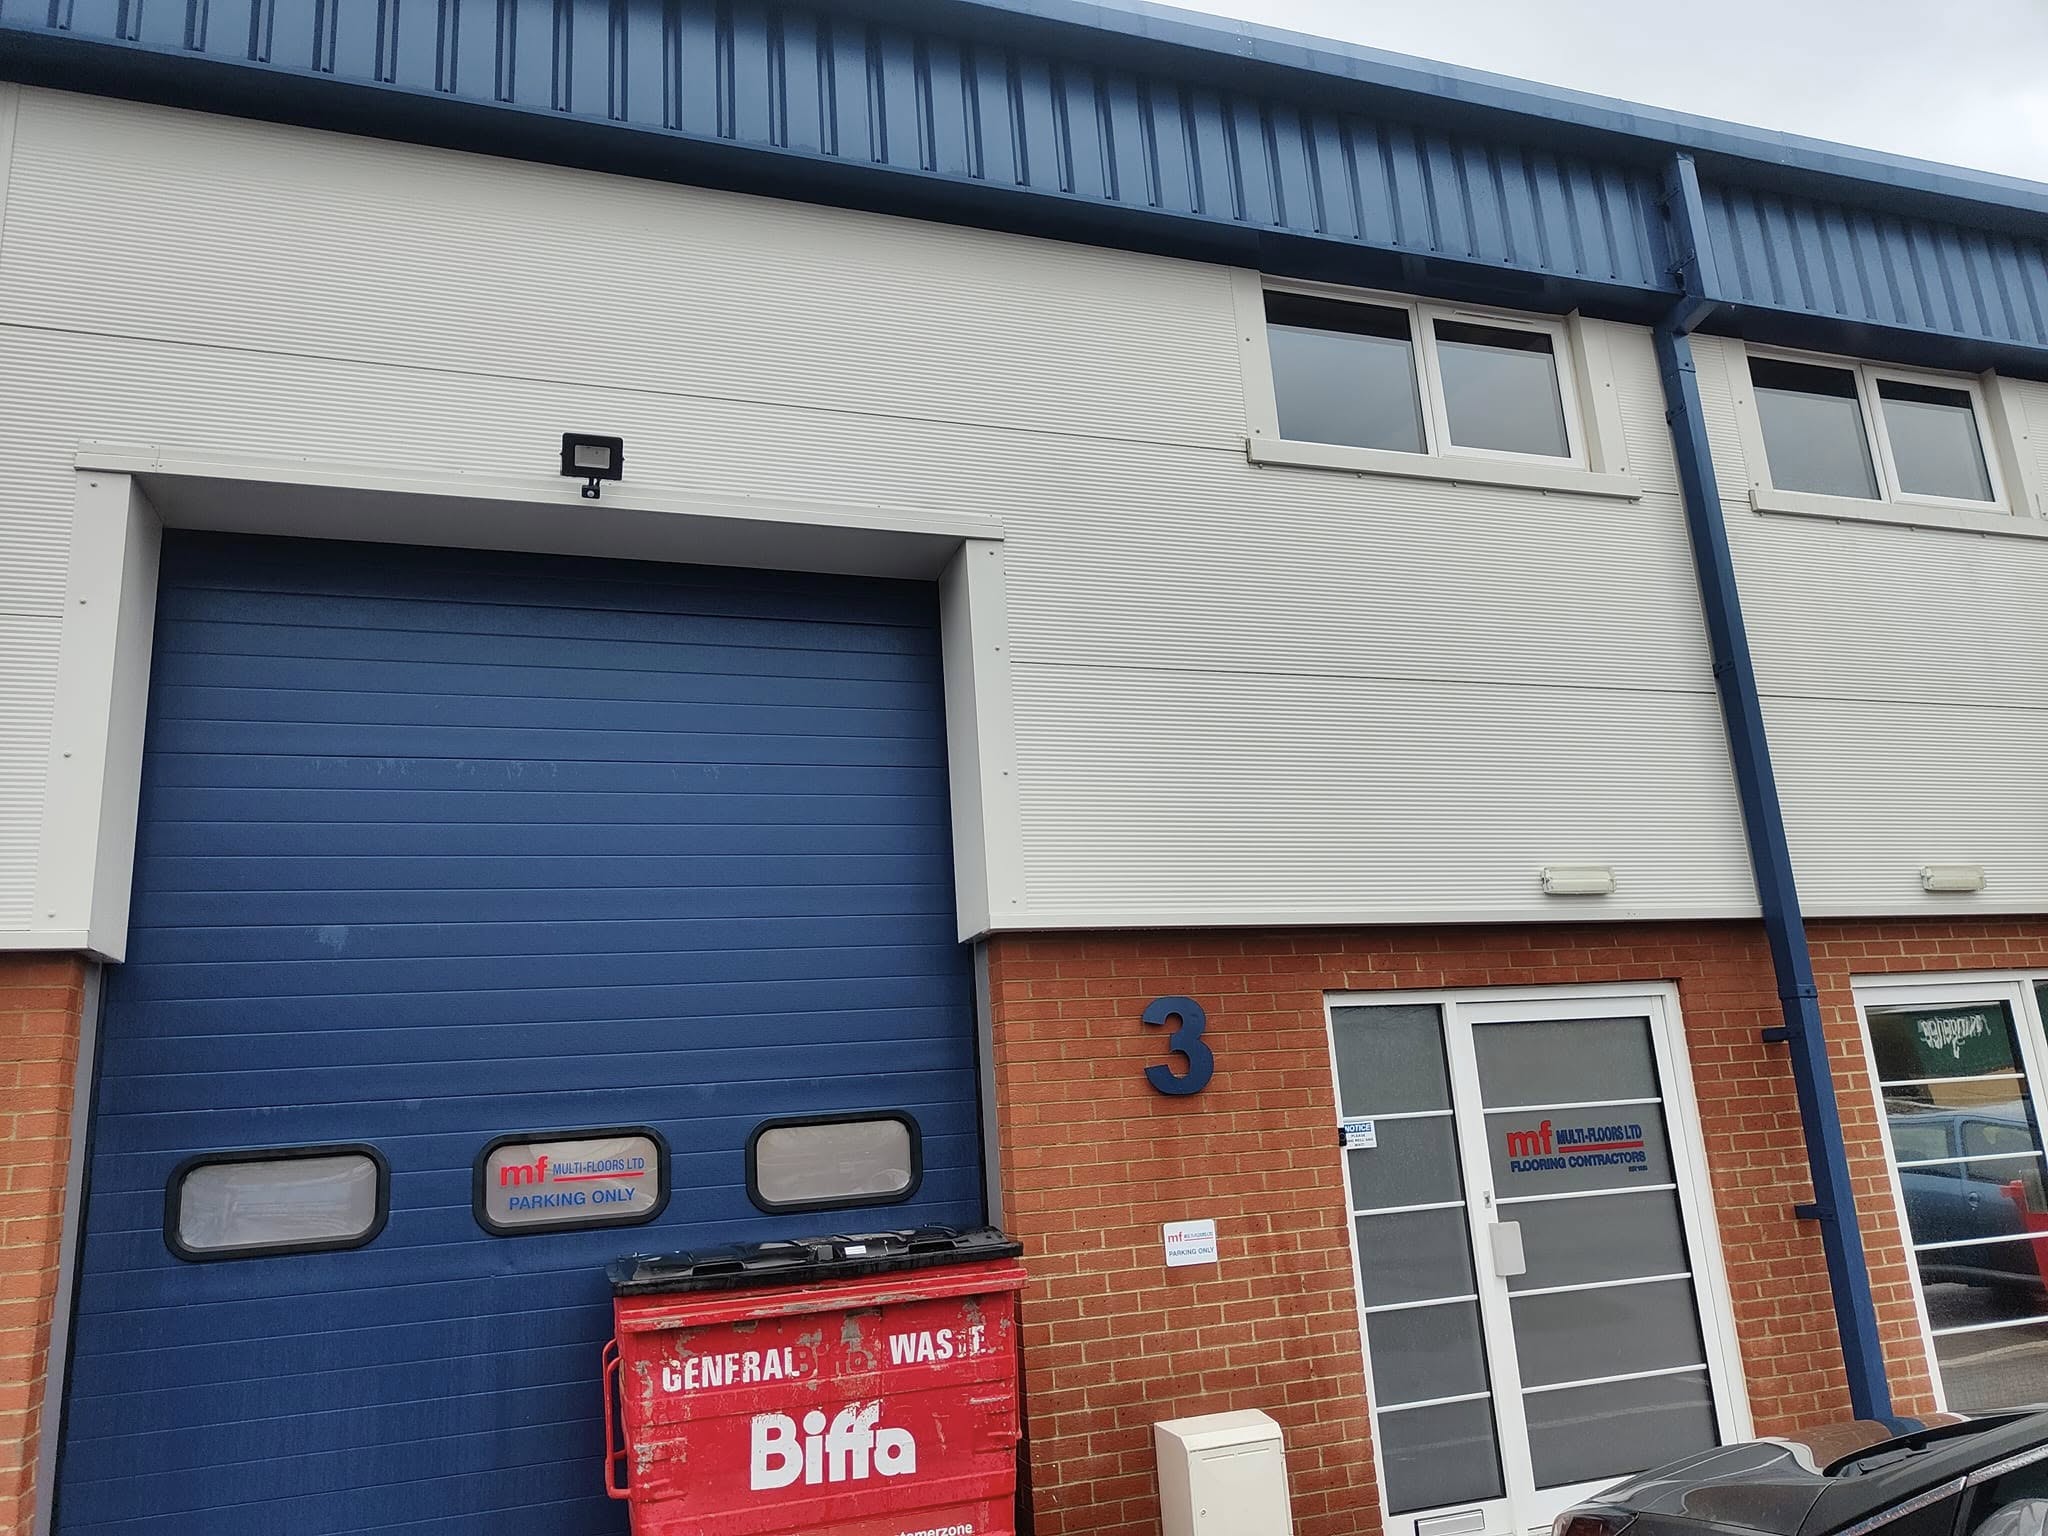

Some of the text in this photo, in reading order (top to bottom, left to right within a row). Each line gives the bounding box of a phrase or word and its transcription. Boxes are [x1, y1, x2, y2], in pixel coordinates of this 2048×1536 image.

[1142, 995, 1214, 1095] 3
[1344, 1124, 1371, 1132] NOTICE
[1506, 1119, 1642, 1158] mf MULTI-FLOORS LTD
[501, 1156, 645, 1187] mf MULTI-FLOORS LTD
[1510, 1157, 1567, 1173] FLOORING
[1568, 1151, 1647, 1169] CONTRACTORS
[509, 1187, 636, 1211] PARKING ONLY
[1167, 1231, 1182, 1243] mf
[1168, 1246, 1214, 1257] PARKING ONLY
[750, 1398, 917, 1491] Biffa
